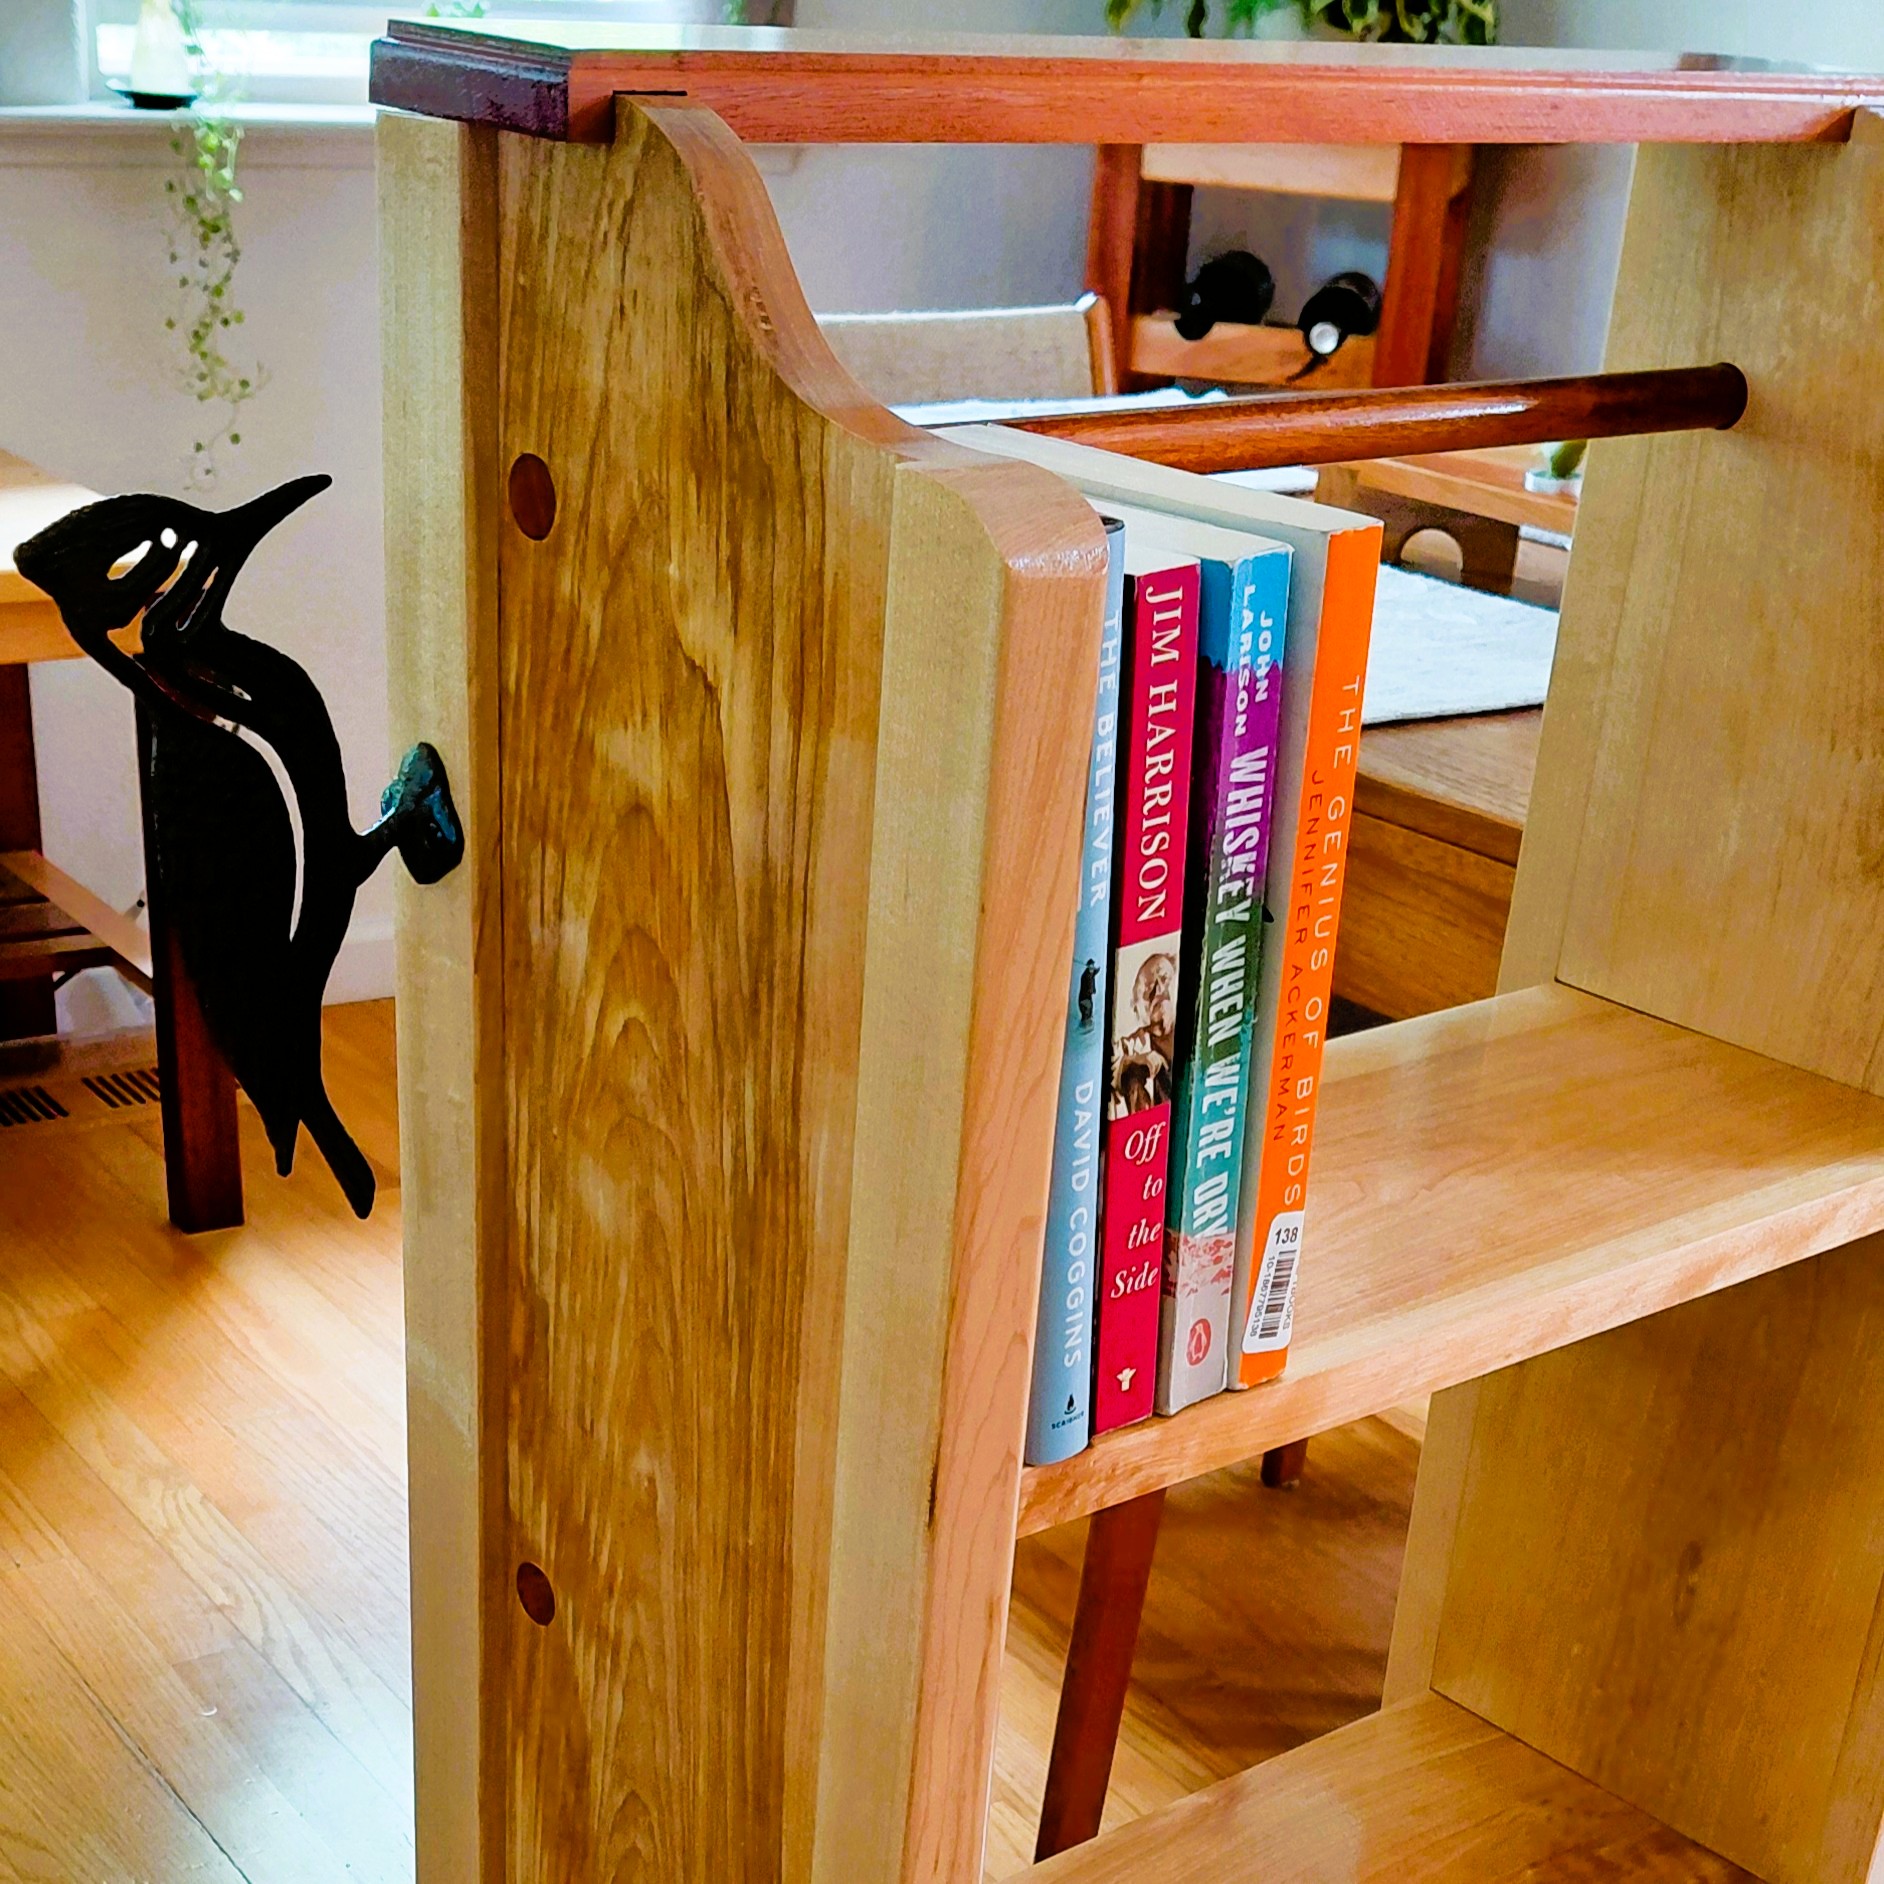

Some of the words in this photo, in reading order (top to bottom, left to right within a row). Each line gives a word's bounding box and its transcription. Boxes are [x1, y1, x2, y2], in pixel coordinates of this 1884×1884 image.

[1099, 610, 1119, 694] THE
[1145, 585, 1184, 667] JIM
[1234, 584, 1256, 737] LARISON
[1255, 610, 1273, 703] JOHN
[1334, 674, 1360, 769] THE
[1090, 712, 1115, 907] BELIEVER
[1137, 679, 1178, 923] HARRISON
[1215, 745, 1269, 924] WHISKEY
[1295, 770, 1324, 945] JENNIFER
[1310, 796, 1346, 971] GENIUS
[1208, 934, 1247, 1048] WHEN
[1303, 996, 1323, 1049] OF
[1273, 964, 1303, 1141] ACKERMAN
[1071, 1080, 1094, 1192] DAVID
[1124, 1121, 1166, 1165] Off
[1196, 1052, 1241, 1168] WE'RE
[1284, 1076, 1314, 1205] BIRDS
[1127, 1218, 1162, 1250] the
[1142, 1174, 1163, 1200] to
[1192, 1170, 1229, 1239] DRY
[1275, 1226, 1299, 1245] 138
[1064, 1207, 1088, 1368] COGGINS
[1110, 1261, 1159, 1299] Side
